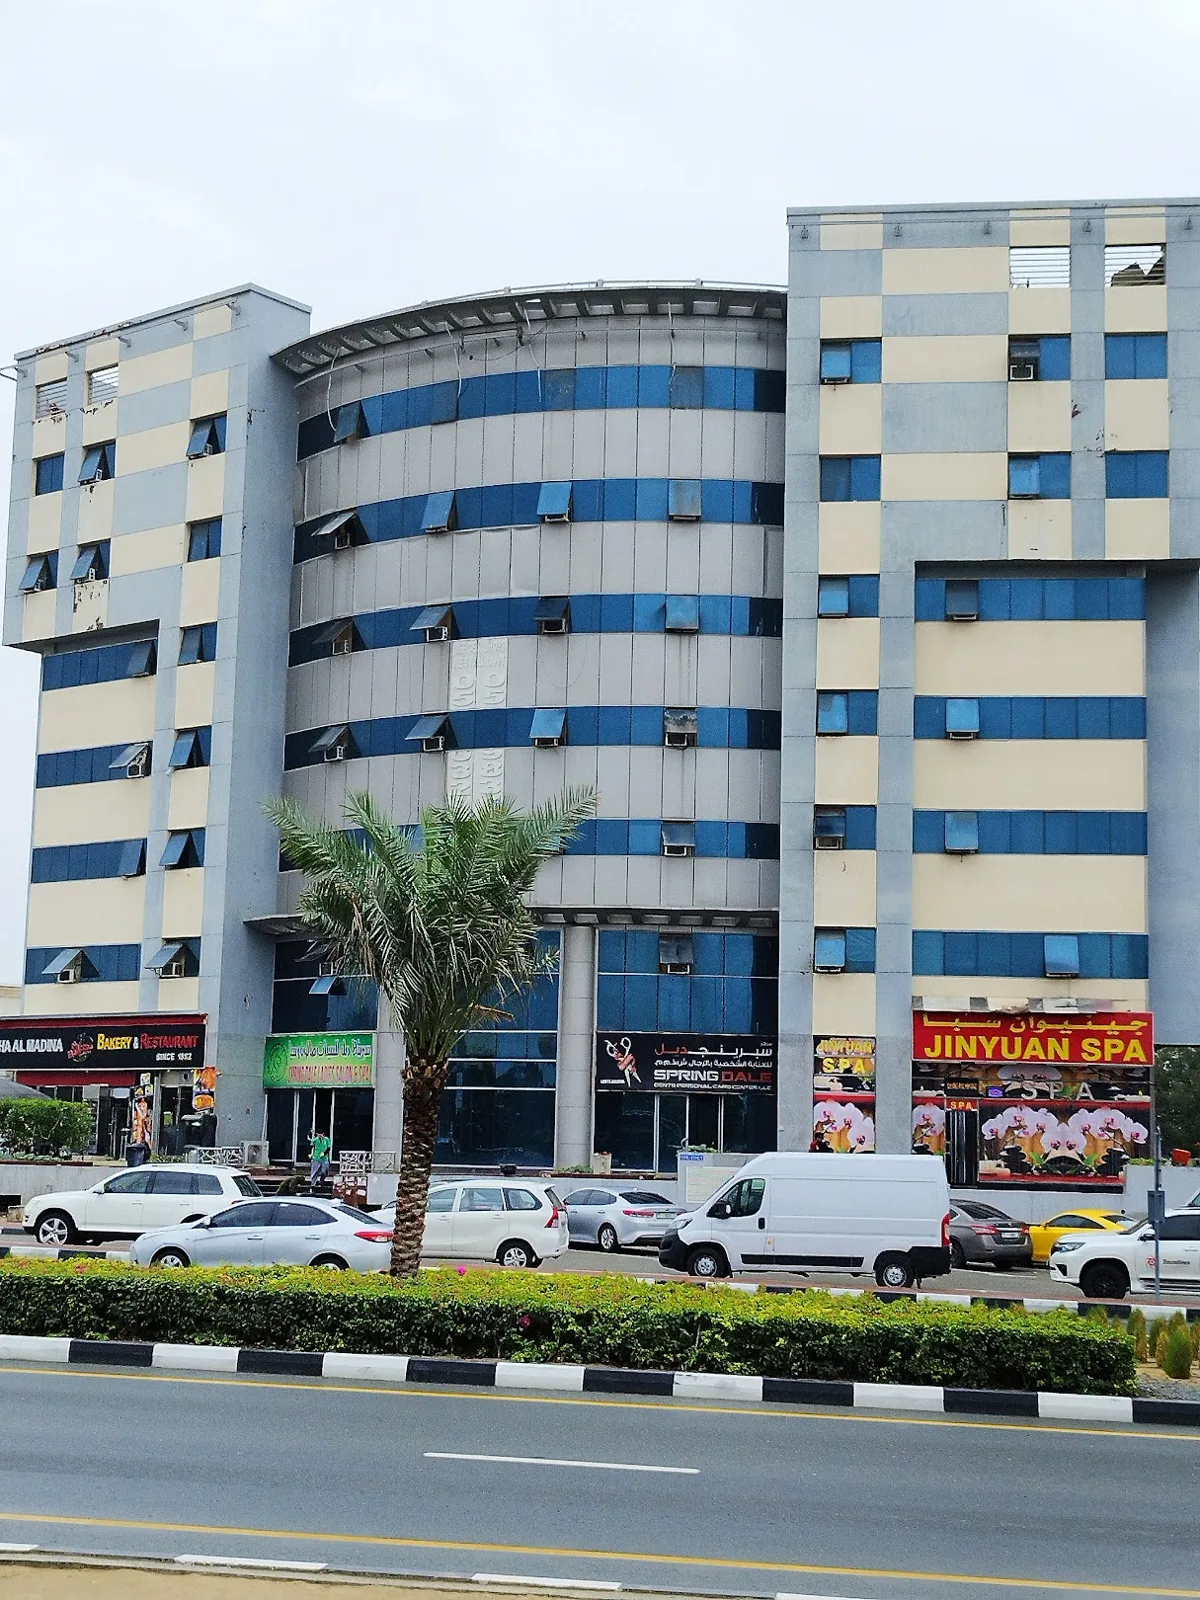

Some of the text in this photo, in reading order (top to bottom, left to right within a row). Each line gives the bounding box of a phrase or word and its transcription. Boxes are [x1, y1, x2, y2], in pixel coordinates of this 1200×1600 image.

[12, 1038, 26, 1052] AL
[26, 1038, 64, 1052] MADINA
[133, 1036, 139, 1049] &
[924, 1035, 1147, 1062] JINYUAN SPA
[156, 1053, 176, 1061] SINCE
[822, 1057, 866, 1073] SPA
[653, 1069, 772, 1083] SPRING DALE
[1021, 1081, 1094, 1101] SPA
[950, 1101, 973, 1110] SPA
